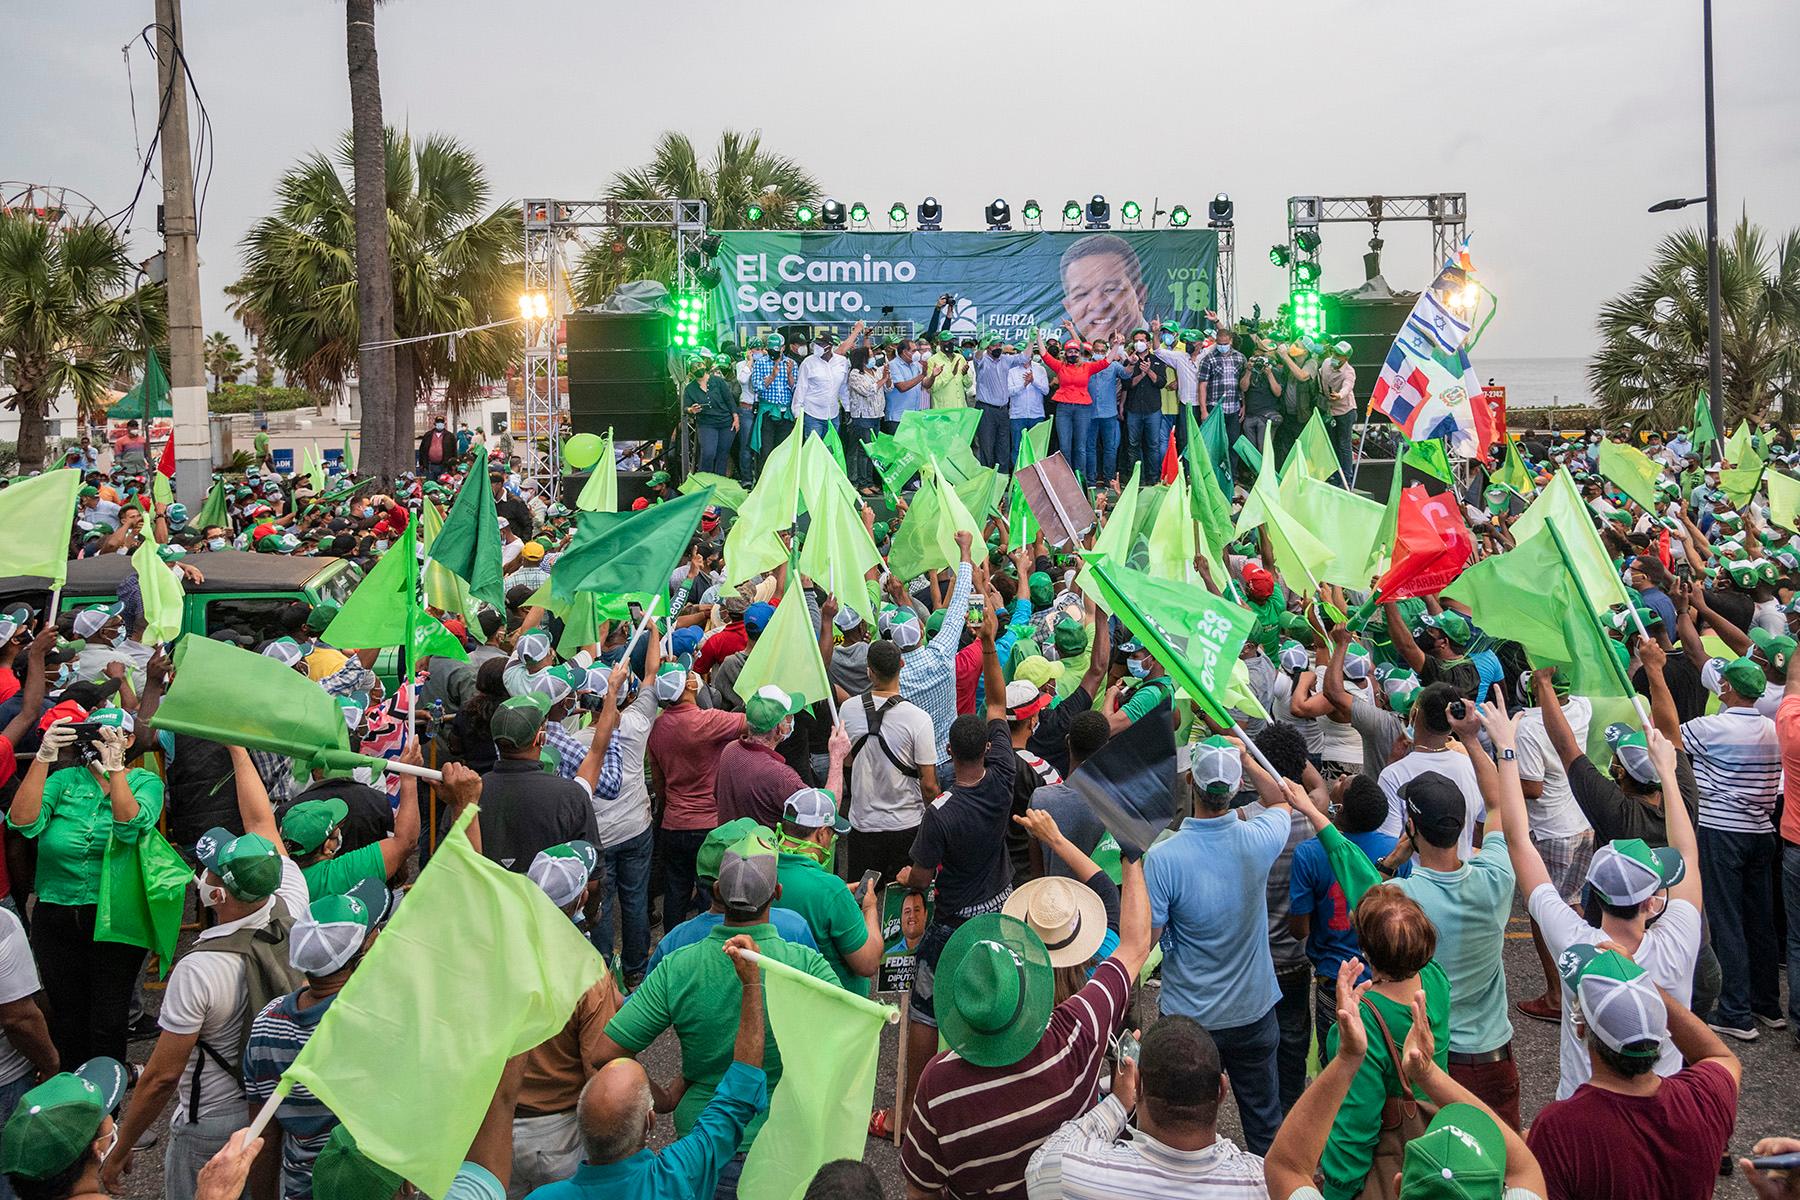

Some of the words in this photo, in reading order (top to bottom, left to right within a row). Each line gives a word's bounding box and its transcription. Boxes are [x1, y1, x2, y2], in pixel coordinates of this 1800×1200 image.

[736, 253, 767, 282] El
[778, 254, 916, 282] Camino
[1167, 268, 1208, 280] VOTA
[737, 285, 871, 320] Seguro.
[1168, 281, 1209, 311] 18
[989, 314, 1035, 326] FUERZA
